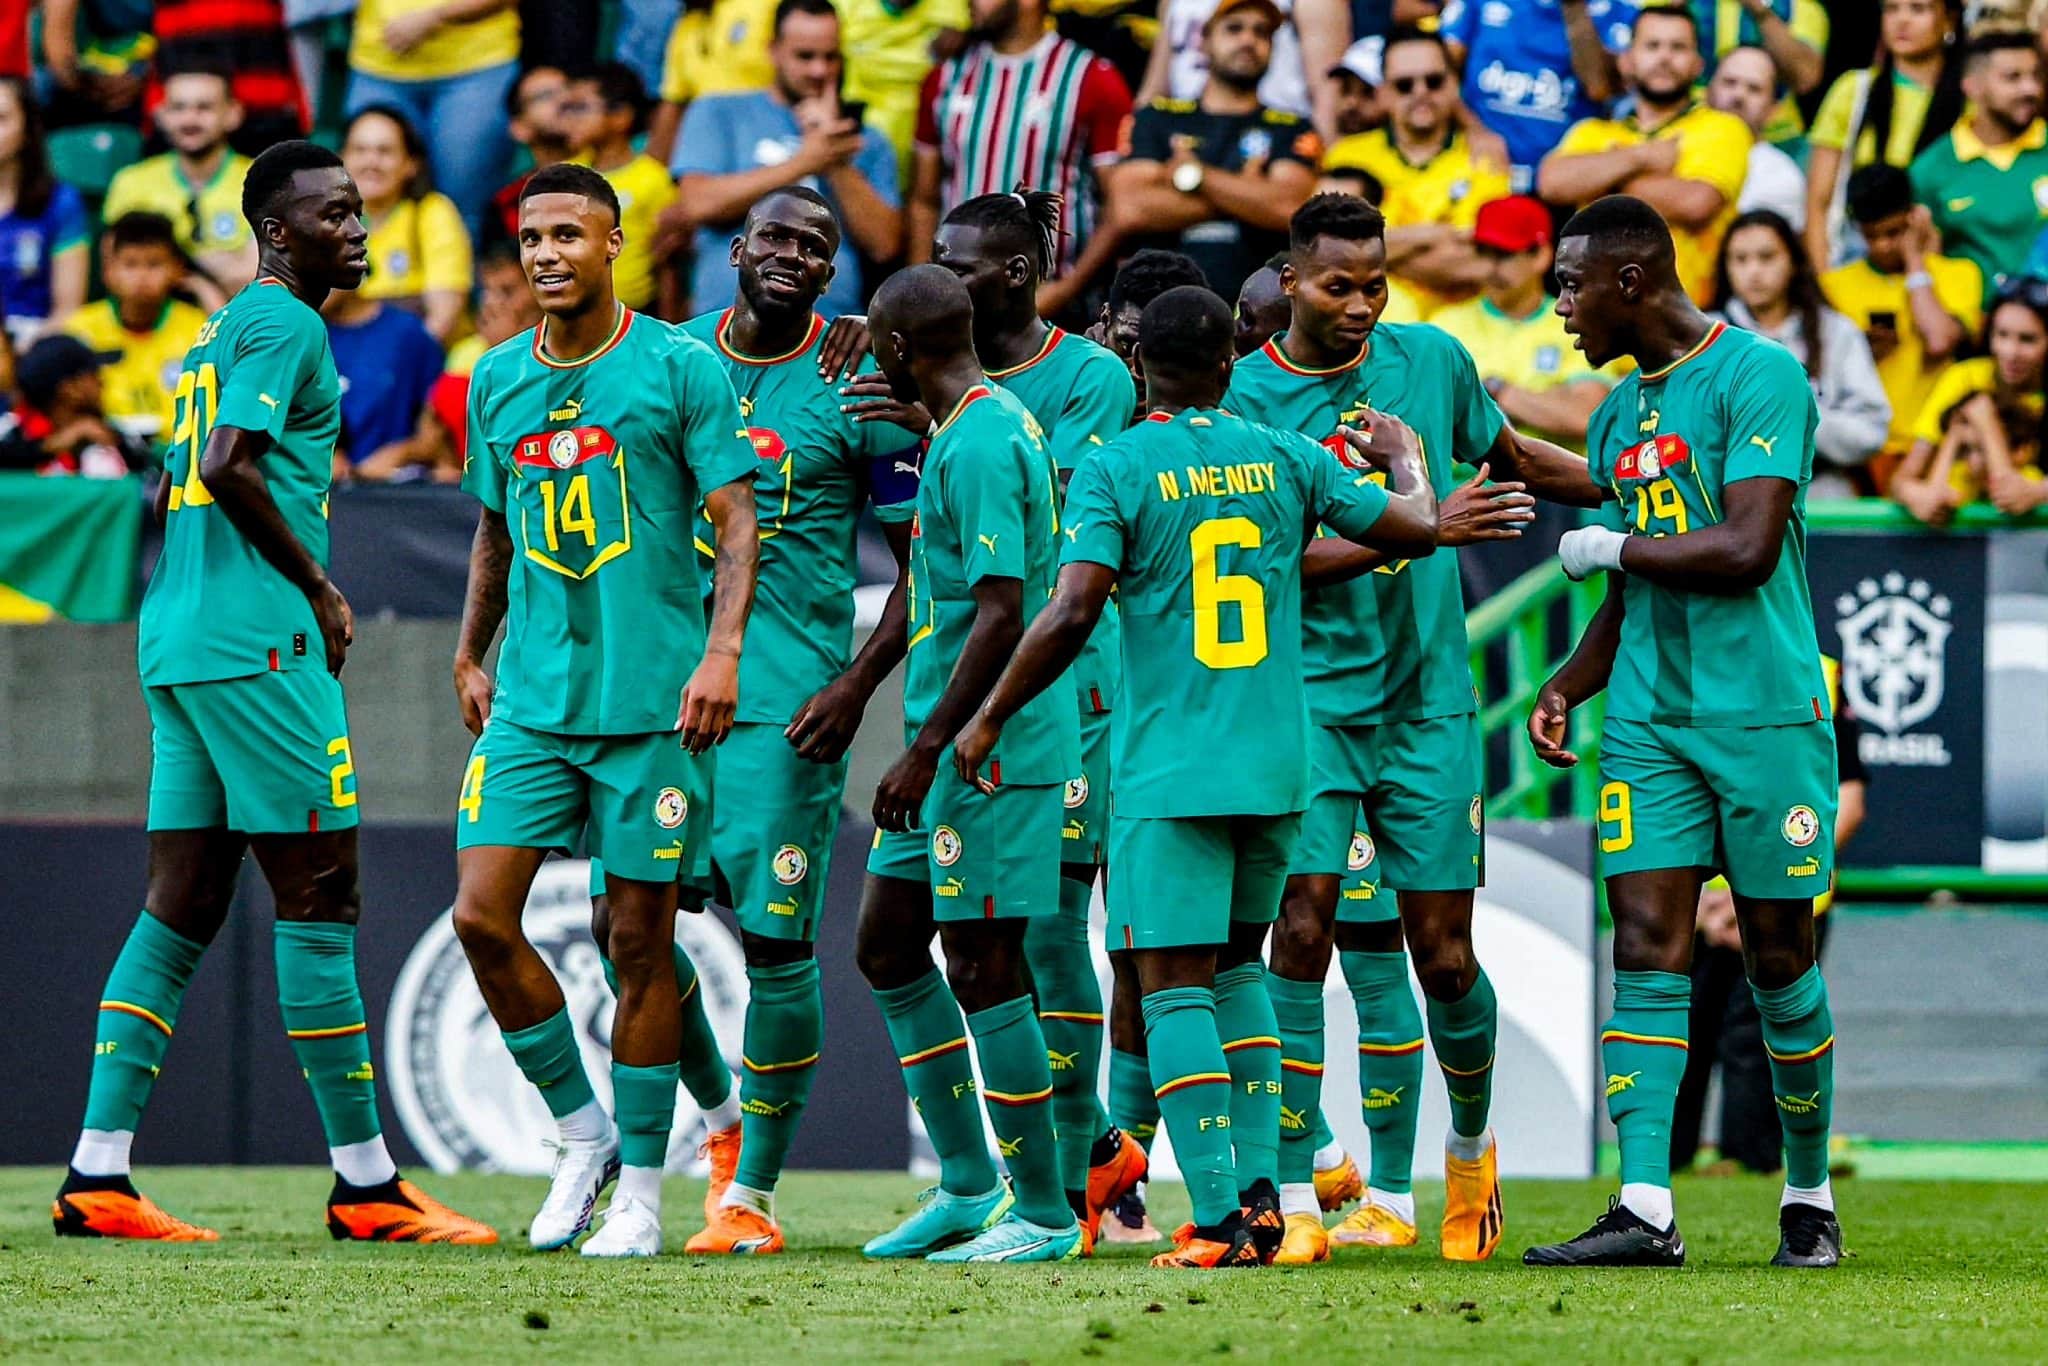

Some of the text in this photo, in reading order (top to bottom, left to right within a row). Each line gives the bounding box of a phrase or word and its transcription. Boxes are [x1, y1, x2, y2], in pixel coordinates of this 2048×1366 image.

[549, 408, 577, 421] PUMA
[1157, 462, 1276, 501] N.MENDY
[540, 475, 597, 551] 14
[1634, 479, 1688, 534] 19
[1190, 517, 1268, 669] 6
[1858, 733, 1952, 766] RASIL
[327, 736, 357, 808] 2
[459, 755, 486, 823] 4
[1600, 782, 1632, 853] 9
[653, 848, 681, 859] PUMA
[1786, 864, 1817, 877] PUMA
[767, 902, 795, 916] PUMA
[1343, 889, 1372, 900] PUMA
